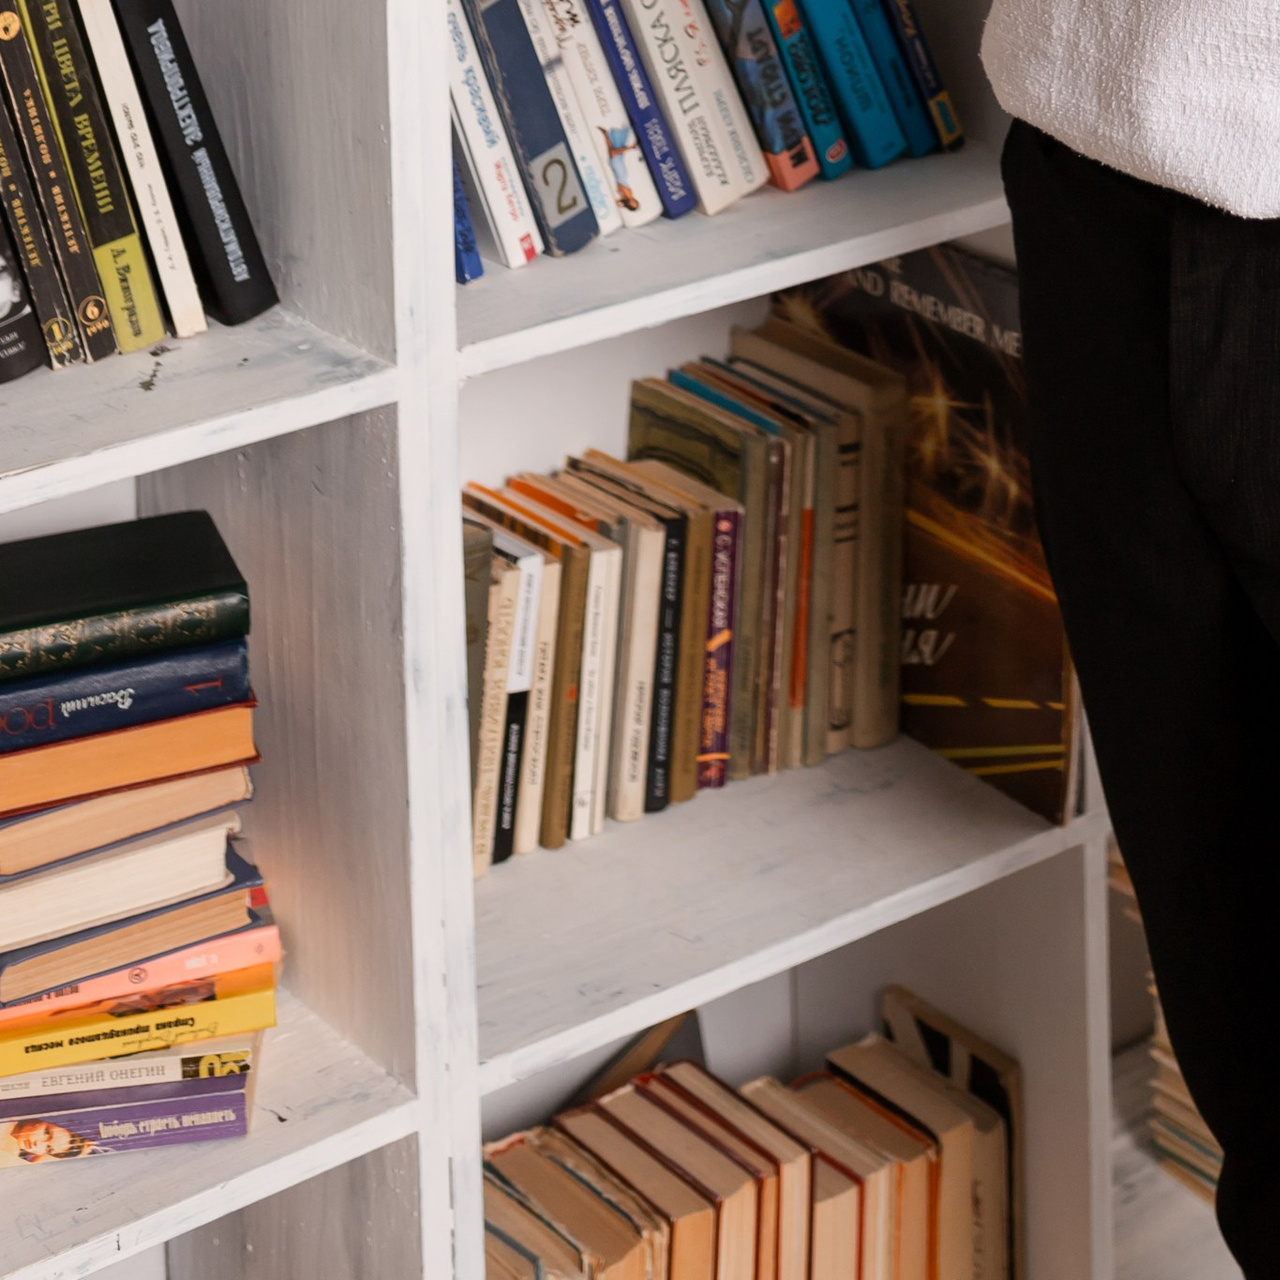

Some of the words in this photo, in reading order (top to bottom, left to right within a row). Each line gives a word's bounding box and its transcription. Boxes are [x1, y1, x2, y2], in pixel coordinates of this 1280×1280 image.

[144, 18, 203, 146] ЭЛЕКТРОПРИВОД
[646, 10, 700, 113] ПЛЯСКА
[745, 26, 788, 109] СТЮАРТ
[19, 87, 53, 164] ПОЛИТИКА
[50, 37, 85, 107] ЦВЕТА
[71, 113, 116, 214] ВРЕМЕНИ
[642, 116, 671, 160] ТВЕН
[542, 157, 578, 215] 2
[10, 197, 40, 269] ДЕТЕКТИВ
[48, 184, 80, 253] ДЕТЕКТИВ
[110, 248, 126, 264] А.
[86, 301, 100, 320] 6
[882, 276, 993, 344] REMEMBER
[986, 322, 1028, 359] ME
[59, 688, 136, 718] Василий
[24, 1039, 64, 1055] месяца
[68, 1023, 151, 1048] тринадцатого
[155, 1017, 196, 1032] Страна
[41, 1068, 105, 1088] ЕВГЕНИЙ
[109, 1064, 166, 1081] ОНЕГИН
